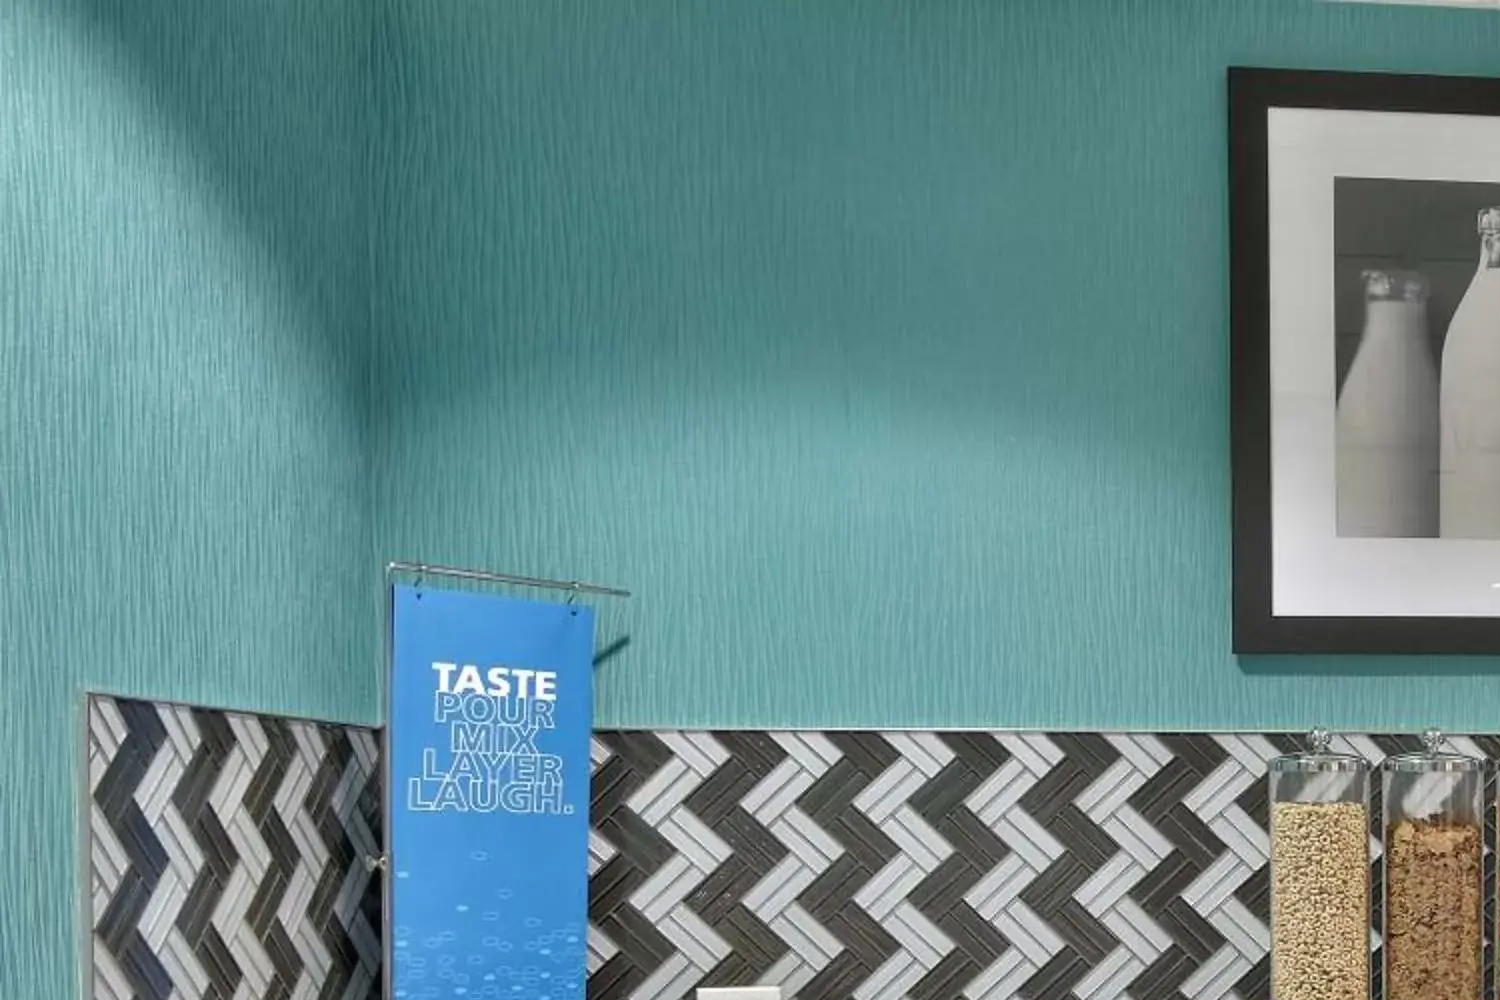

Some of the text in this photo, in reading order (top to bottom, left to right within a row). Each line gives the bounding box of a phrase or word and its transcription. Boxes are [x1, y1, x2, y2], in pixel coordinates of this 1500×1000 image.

[432, 662, 557, 701] TASTE
[434, 689, 555, 729] POUR
[452, 720, 539, 755] MIX
[423, 748, 563, 785] LAYER
[407, 778, 574, 815] LAUGH.
